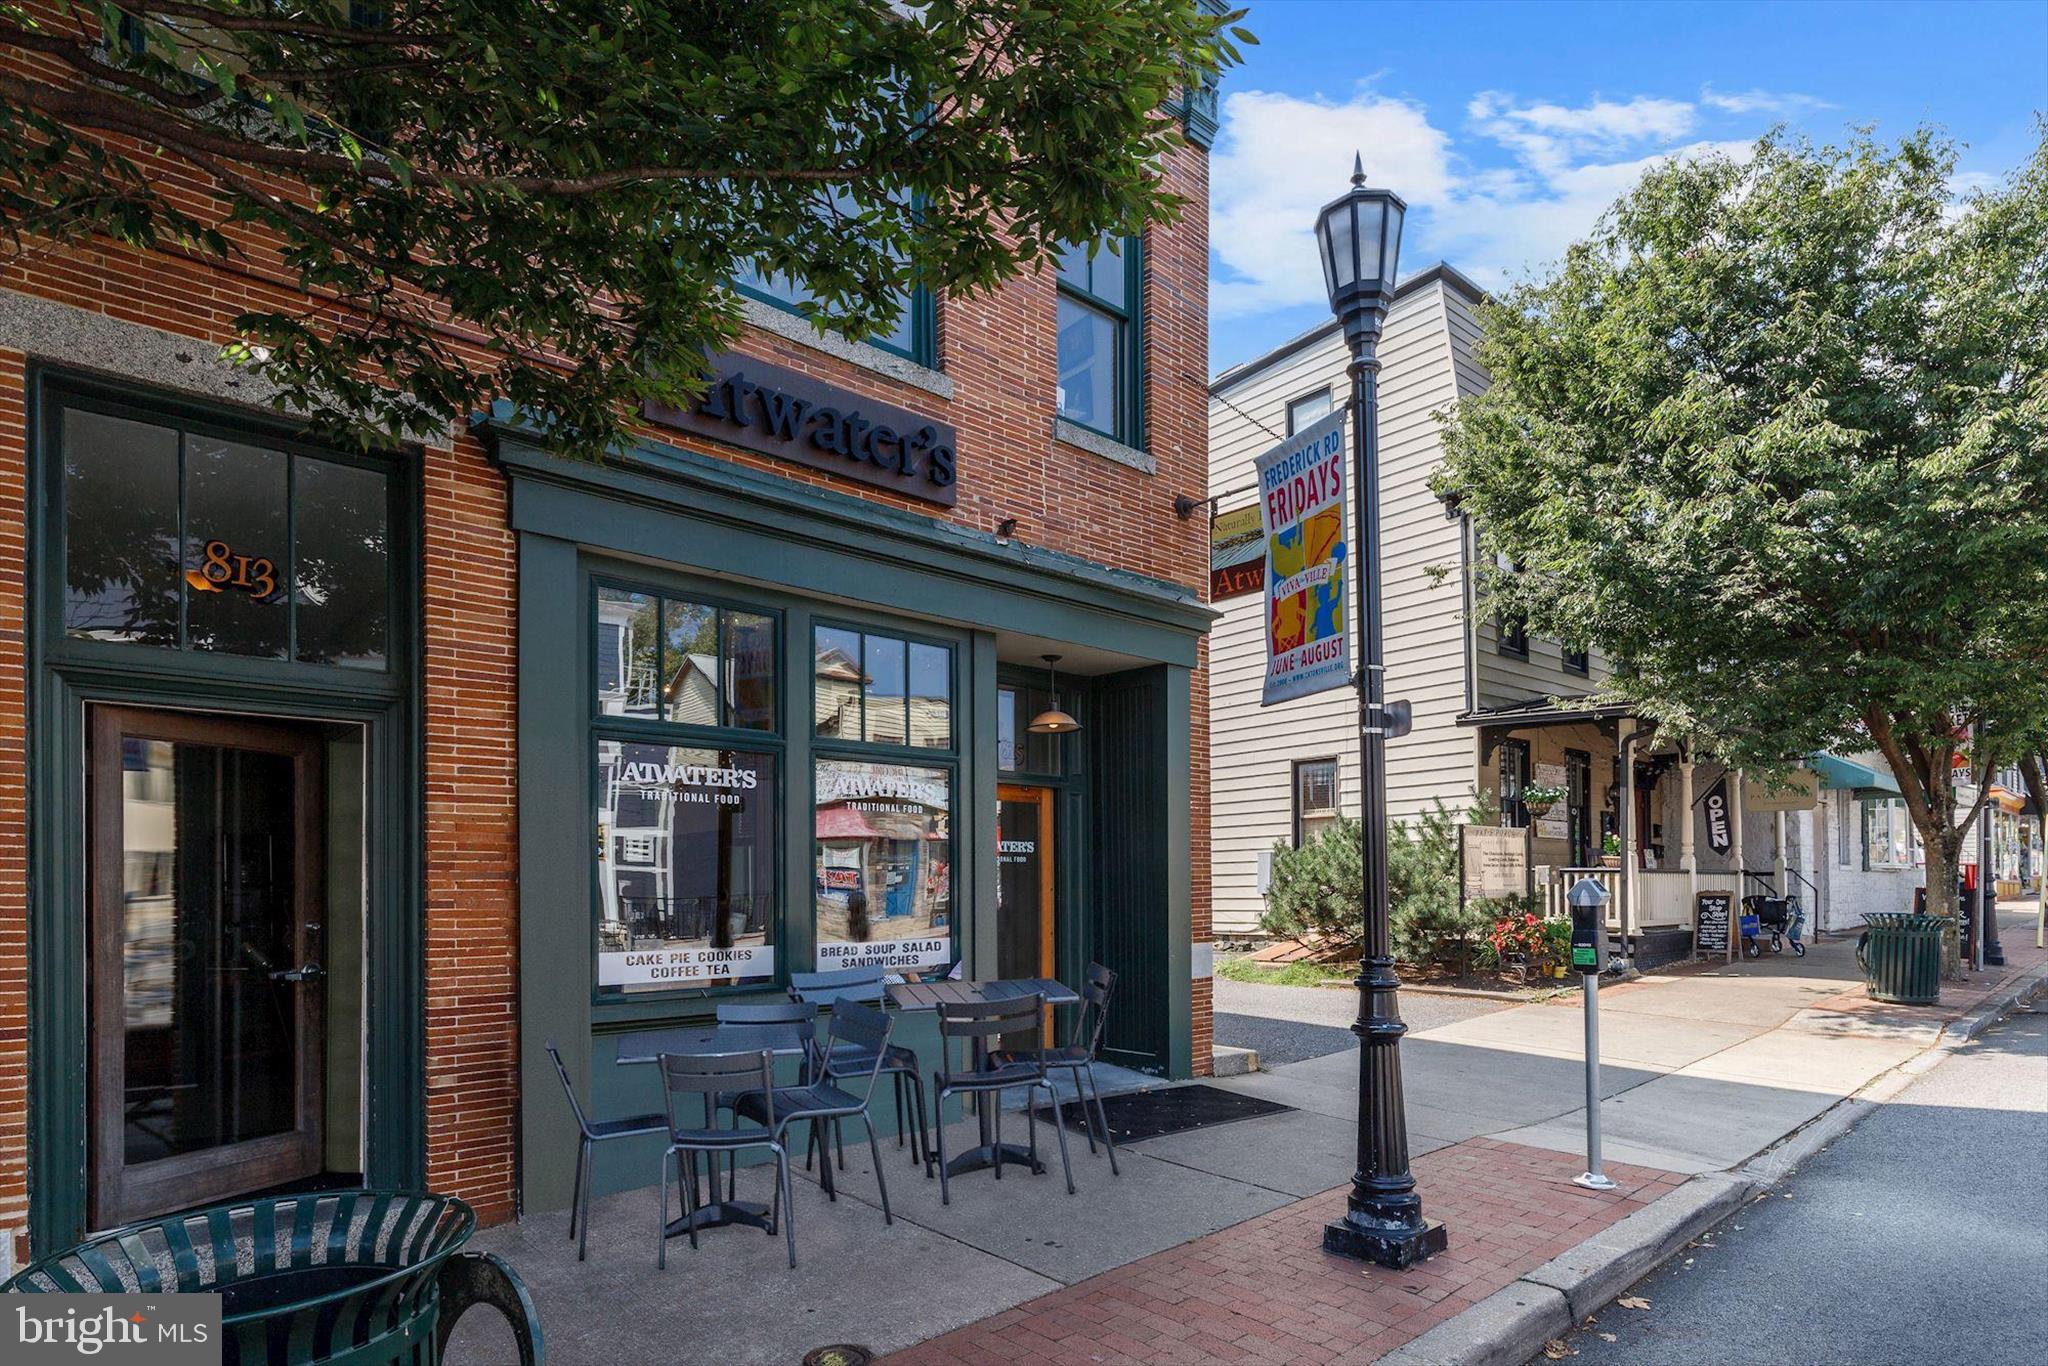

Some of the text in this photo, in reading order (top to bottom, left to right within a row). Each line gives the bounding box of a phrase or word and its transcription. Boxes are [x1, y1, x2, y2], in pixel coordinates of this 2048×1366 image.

[1264, 430, 1340, 490] FREDERICK RD
[1267, 454, 1340, 530] FRIDAYS
[202, 541, 275, 599] 813
[1281, 567, 1328, 596] VIVA VILLE
[1270, 637, 1344, 677] JUNE AUGUST
[621, 761, 758, 789] ATWATER'S
[639, 789, 741, 805] TRADITIONAL FOOD
[846, 801, 924, 814] TRADITIONAL FOOD
[1708, 795, 1729, 848] OPEN
[1013, 855, 1027, 863] FOOD
[626, 949, 752, 967] CAKE PIE COOKIES
[821, 941, 942, 958] BREAD SOUP SALAD
[651, 964, 730, 979] COFFEE TEA
[841, 954, 920, 969] SANDWICHES
